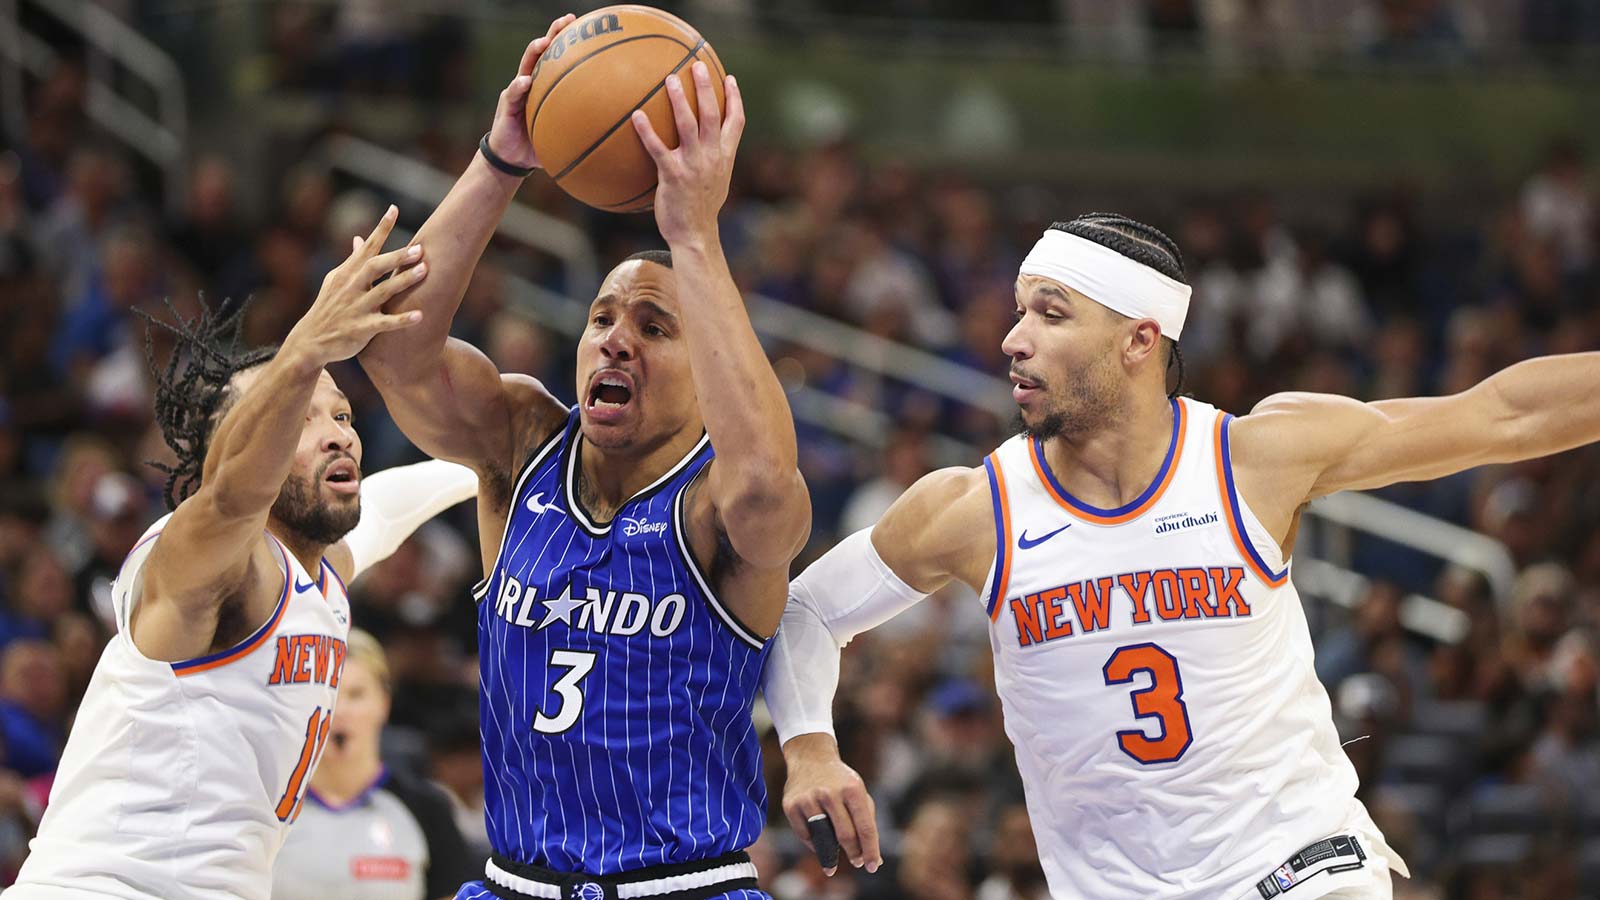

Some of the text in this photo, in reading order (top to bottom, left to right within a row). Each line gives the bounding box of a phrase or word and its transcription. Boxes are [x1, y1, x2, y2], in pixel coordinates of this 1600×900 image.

[1155, 511, 1218, 534] abu dhabi
[495, 567, 687, 638] RLANDO
[1010, 566, 1252, 648] NEW YORK
[268, 633, 332, 685] NEW
[532, 649, 597, 734] 3
[1102, 641, 1194, 765] 3
